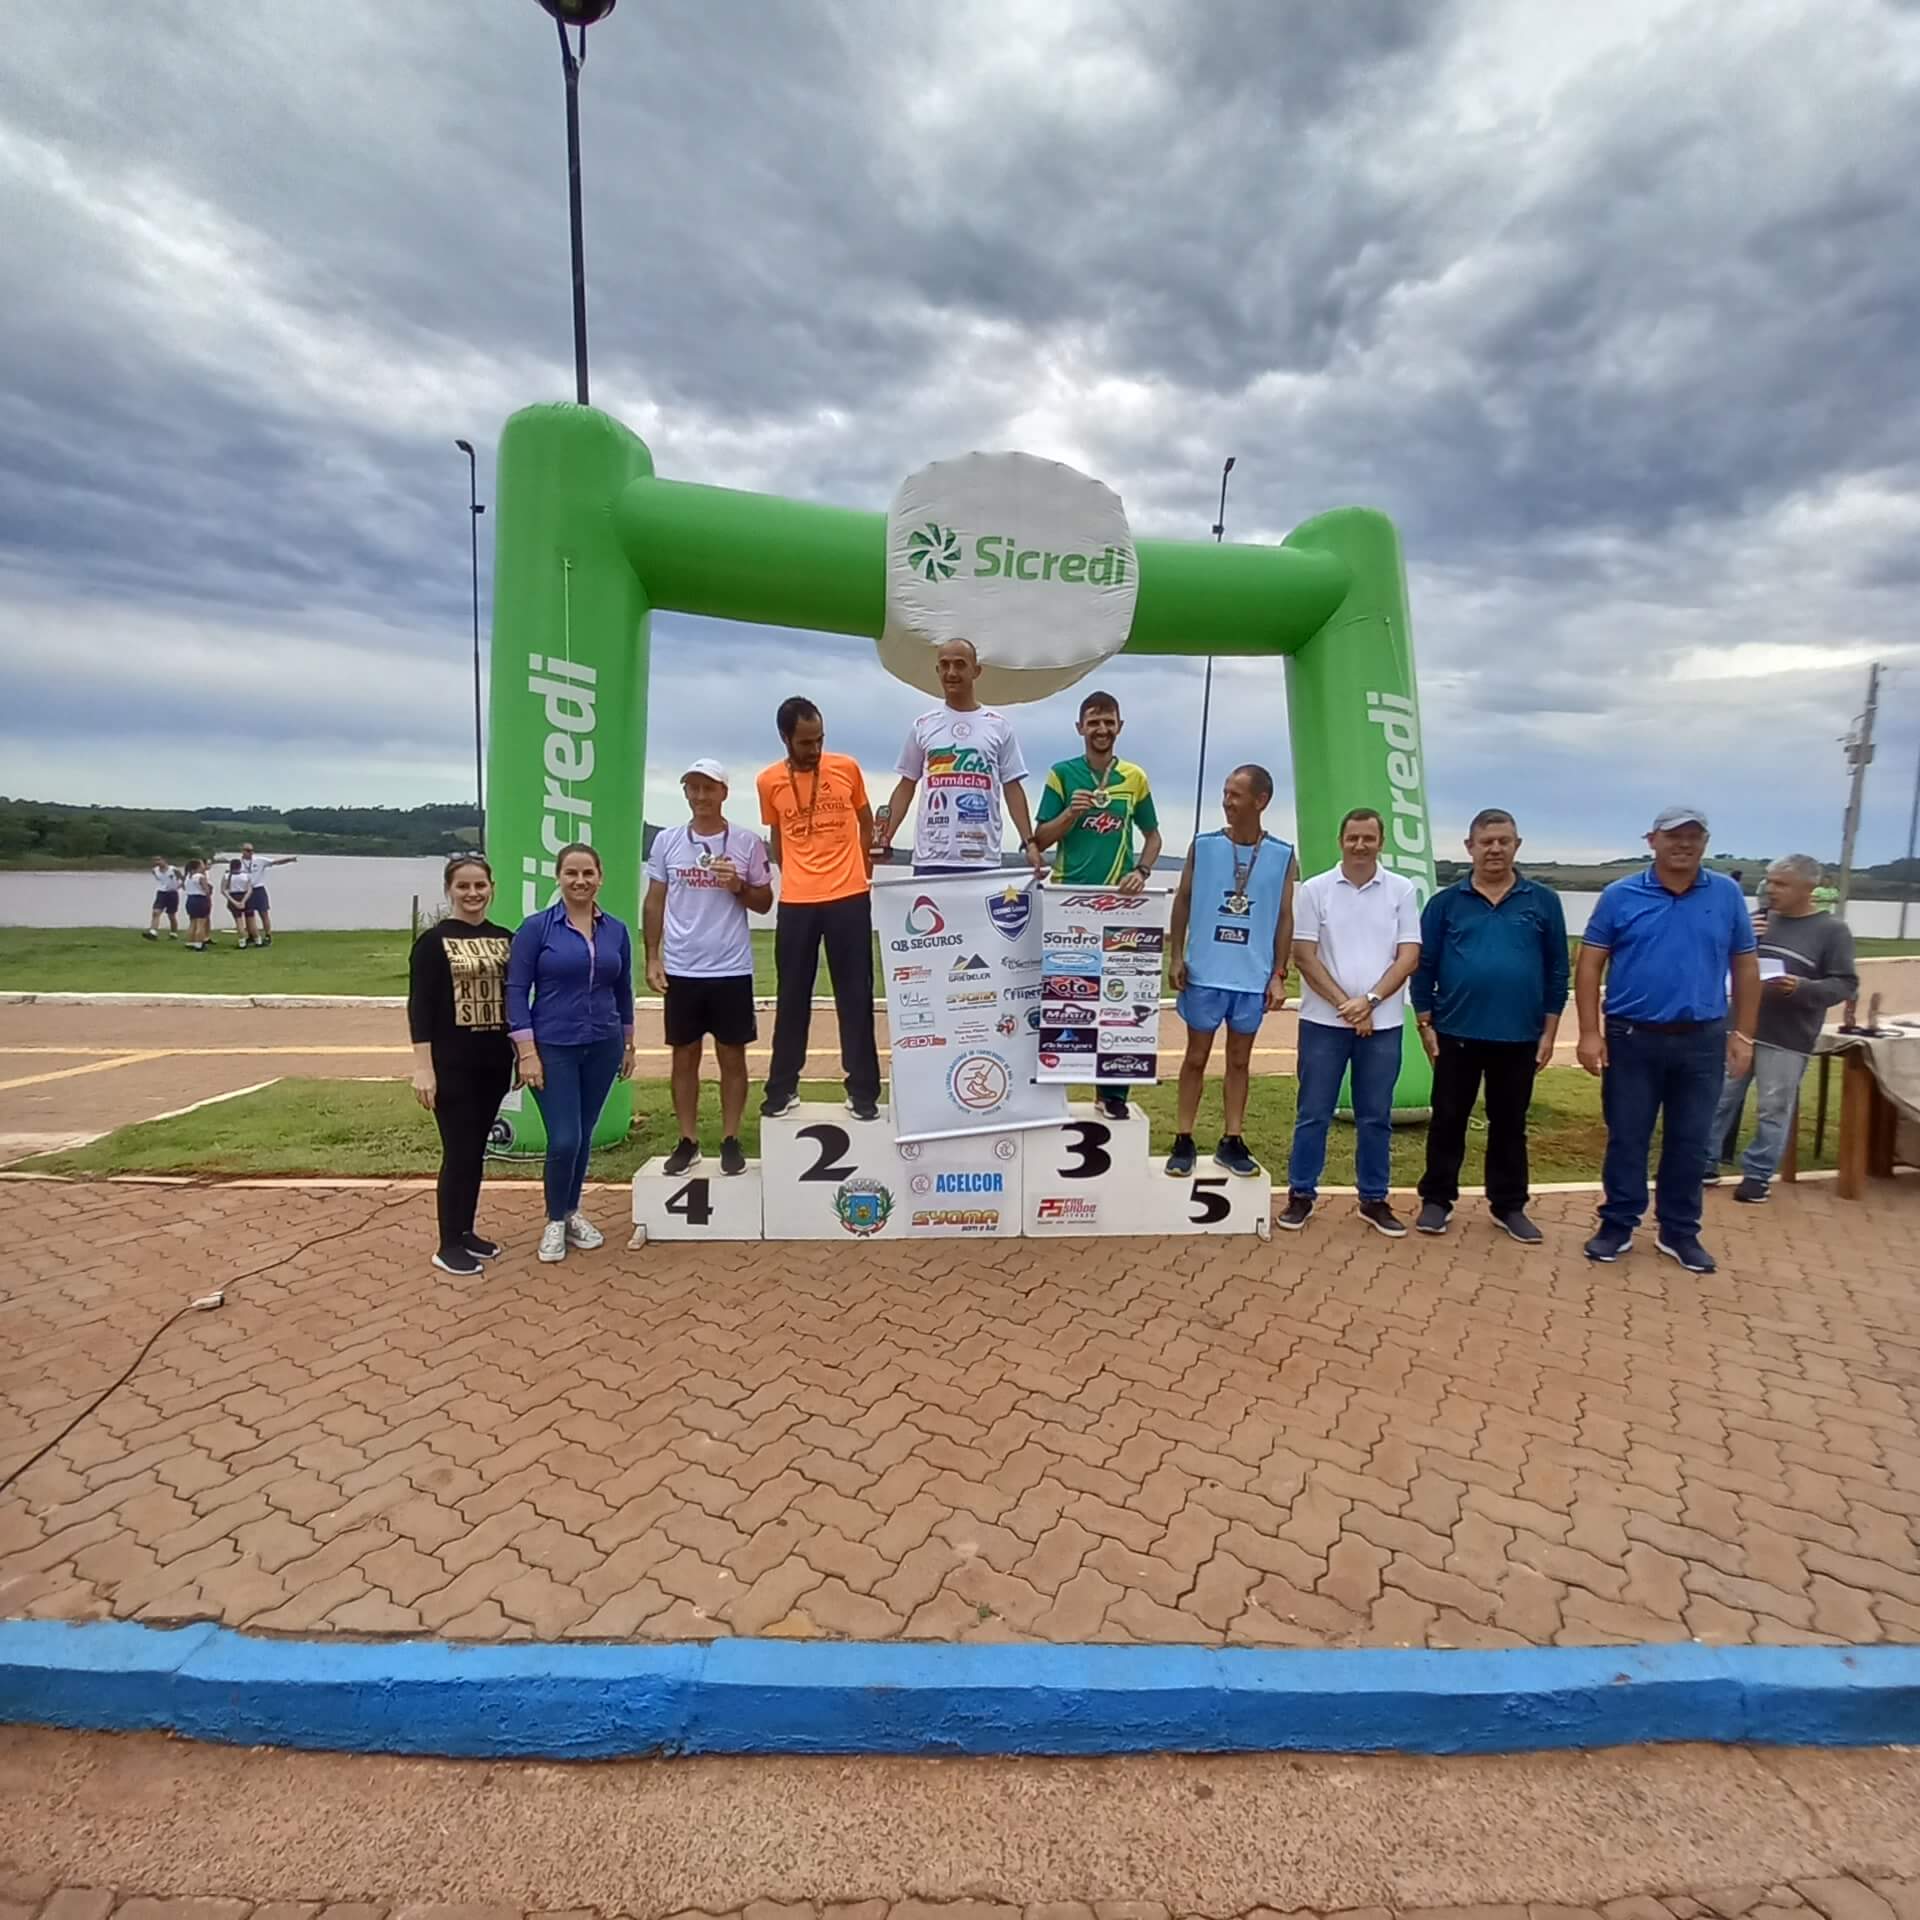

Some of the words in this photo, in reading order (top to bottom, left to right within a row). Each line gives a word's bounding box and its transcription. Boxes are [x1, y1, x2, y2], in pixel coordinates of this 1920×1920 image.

[974, 536, 1125, 586] Sicredi
[891, 940, 909, 951] QB
[910, 934, 963, 950] SEGUROS
[1043, 932, 1099, 945] Sandro
[1112, 932, 1161, 944] SulCar
[796, 1124, 859, 1182] 2
[1057, 1121, 1112, 1179] 3
[936, 1173, 1003, 1192] ACELCOR
[665, 1178, 713, 1225] 4
[1188, 1178, 1231, 1224] 5
[912, 1209, 999, 1226] SYOMA
